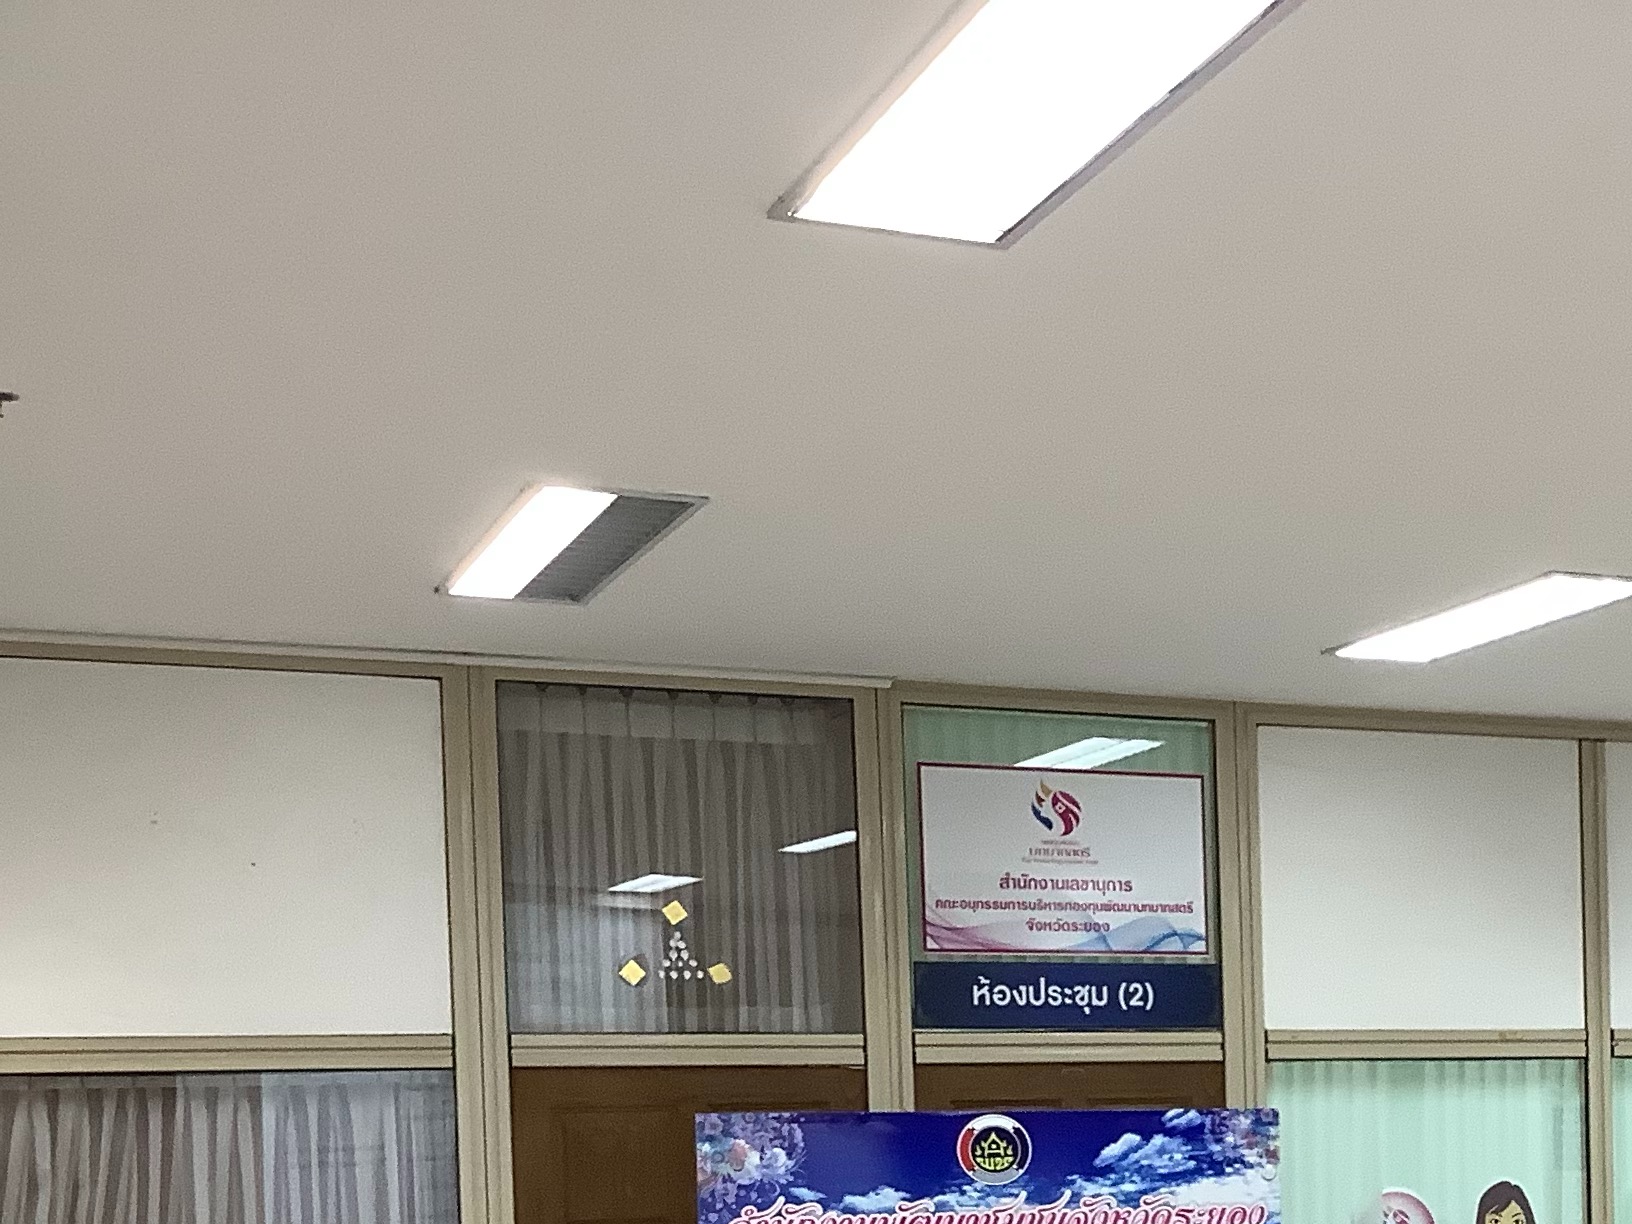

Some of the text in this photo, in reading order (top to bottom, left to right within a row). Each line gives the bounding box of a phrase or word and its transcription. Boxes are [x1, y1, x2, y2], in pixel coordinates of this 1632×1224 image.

[999, 872, 1133, 896] สำนักงานเลขานุการ
[1026, 917, 1110, 932] จังหวัดระยอง
[972, 975, 1154, 1015] ห้องประชุม (2)
